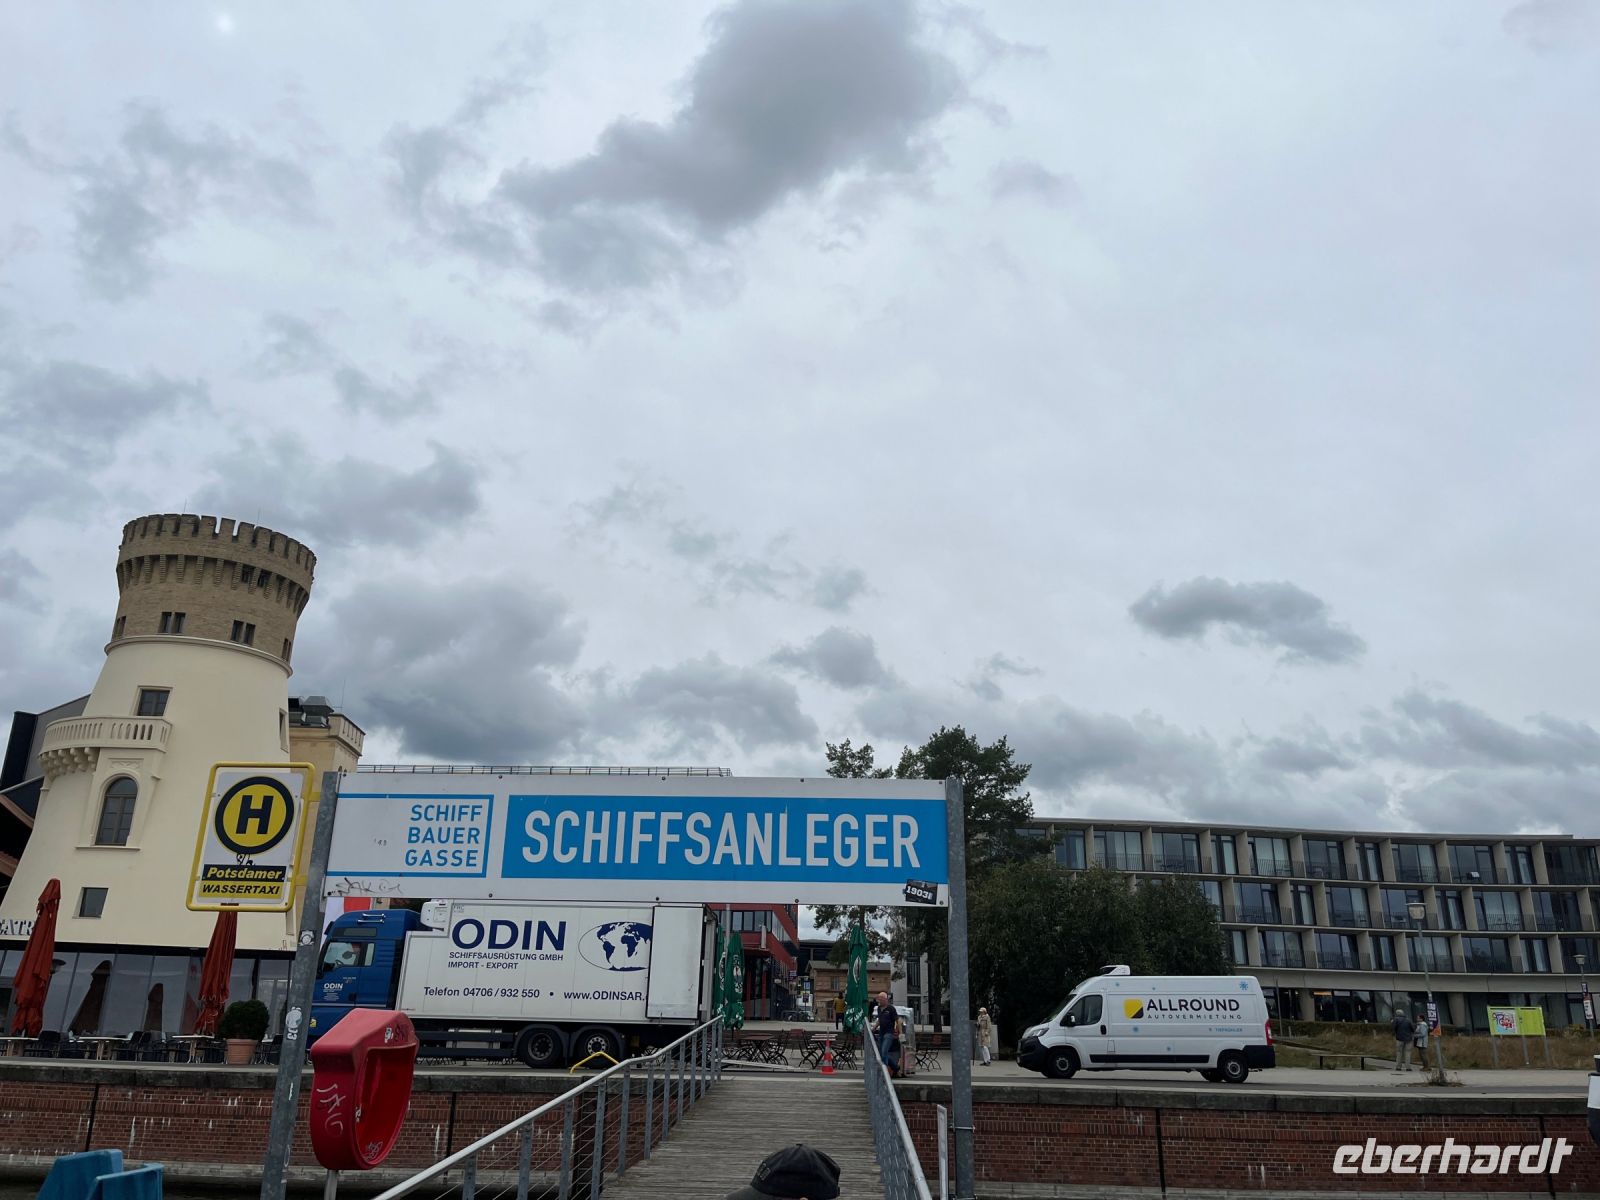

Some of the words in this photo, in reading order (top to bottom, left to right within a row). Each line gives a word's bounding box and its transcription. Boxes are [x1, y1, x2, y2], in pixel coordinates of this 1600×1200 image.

[236, 795, 274, 834] H
[410, 804, 483, 822] SCHIFF
[407, 826, 480, 844] BAUER
[522, 809, 920, 868] SCHIFFSANLEGER
[404, 849, 479, 867] GASSE
[206, 867, 282, 879] Potsdamer
[202, 884, 280, 895] WASSERTAXI
[452, 918, 566, 951] ODIN
[449, 951, 537, 960] SCHIFFSAUSRÜSTUNG
[538, 953, 564, 961] GMBH
[448, 961, 480, 969] IMPORT
[424, 986, 460, 997] Telefon
[521, 988, 540, 998] 550
[563, 990, 646, 1001] www.ODINSAR.
[1147, 998, 1240, 1011] ALLROUND
